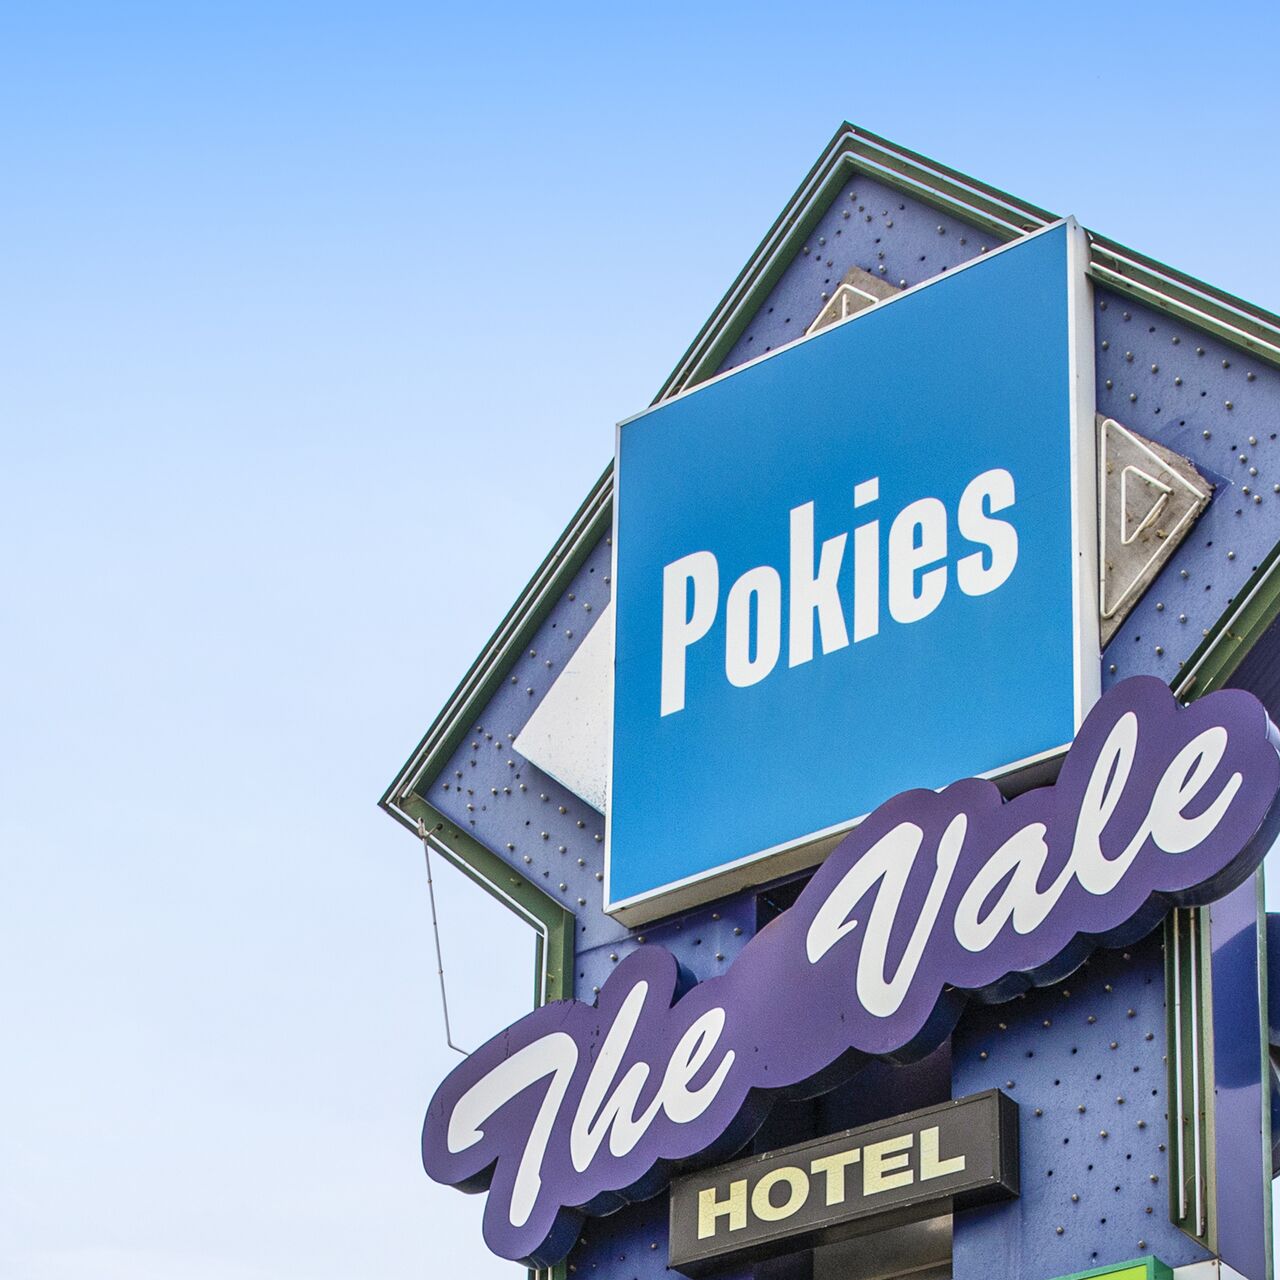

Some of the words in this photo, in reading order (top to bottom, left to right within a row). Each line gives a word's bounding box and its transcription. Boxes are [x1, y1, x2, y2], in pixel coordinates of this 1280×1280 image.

[660, 468, 1019, 718] Pokies
[446, 979, 735, 1228] The
[806, 710, 1244, 1018] Vale
[697, 1125, 966, 1240] HOTEL
